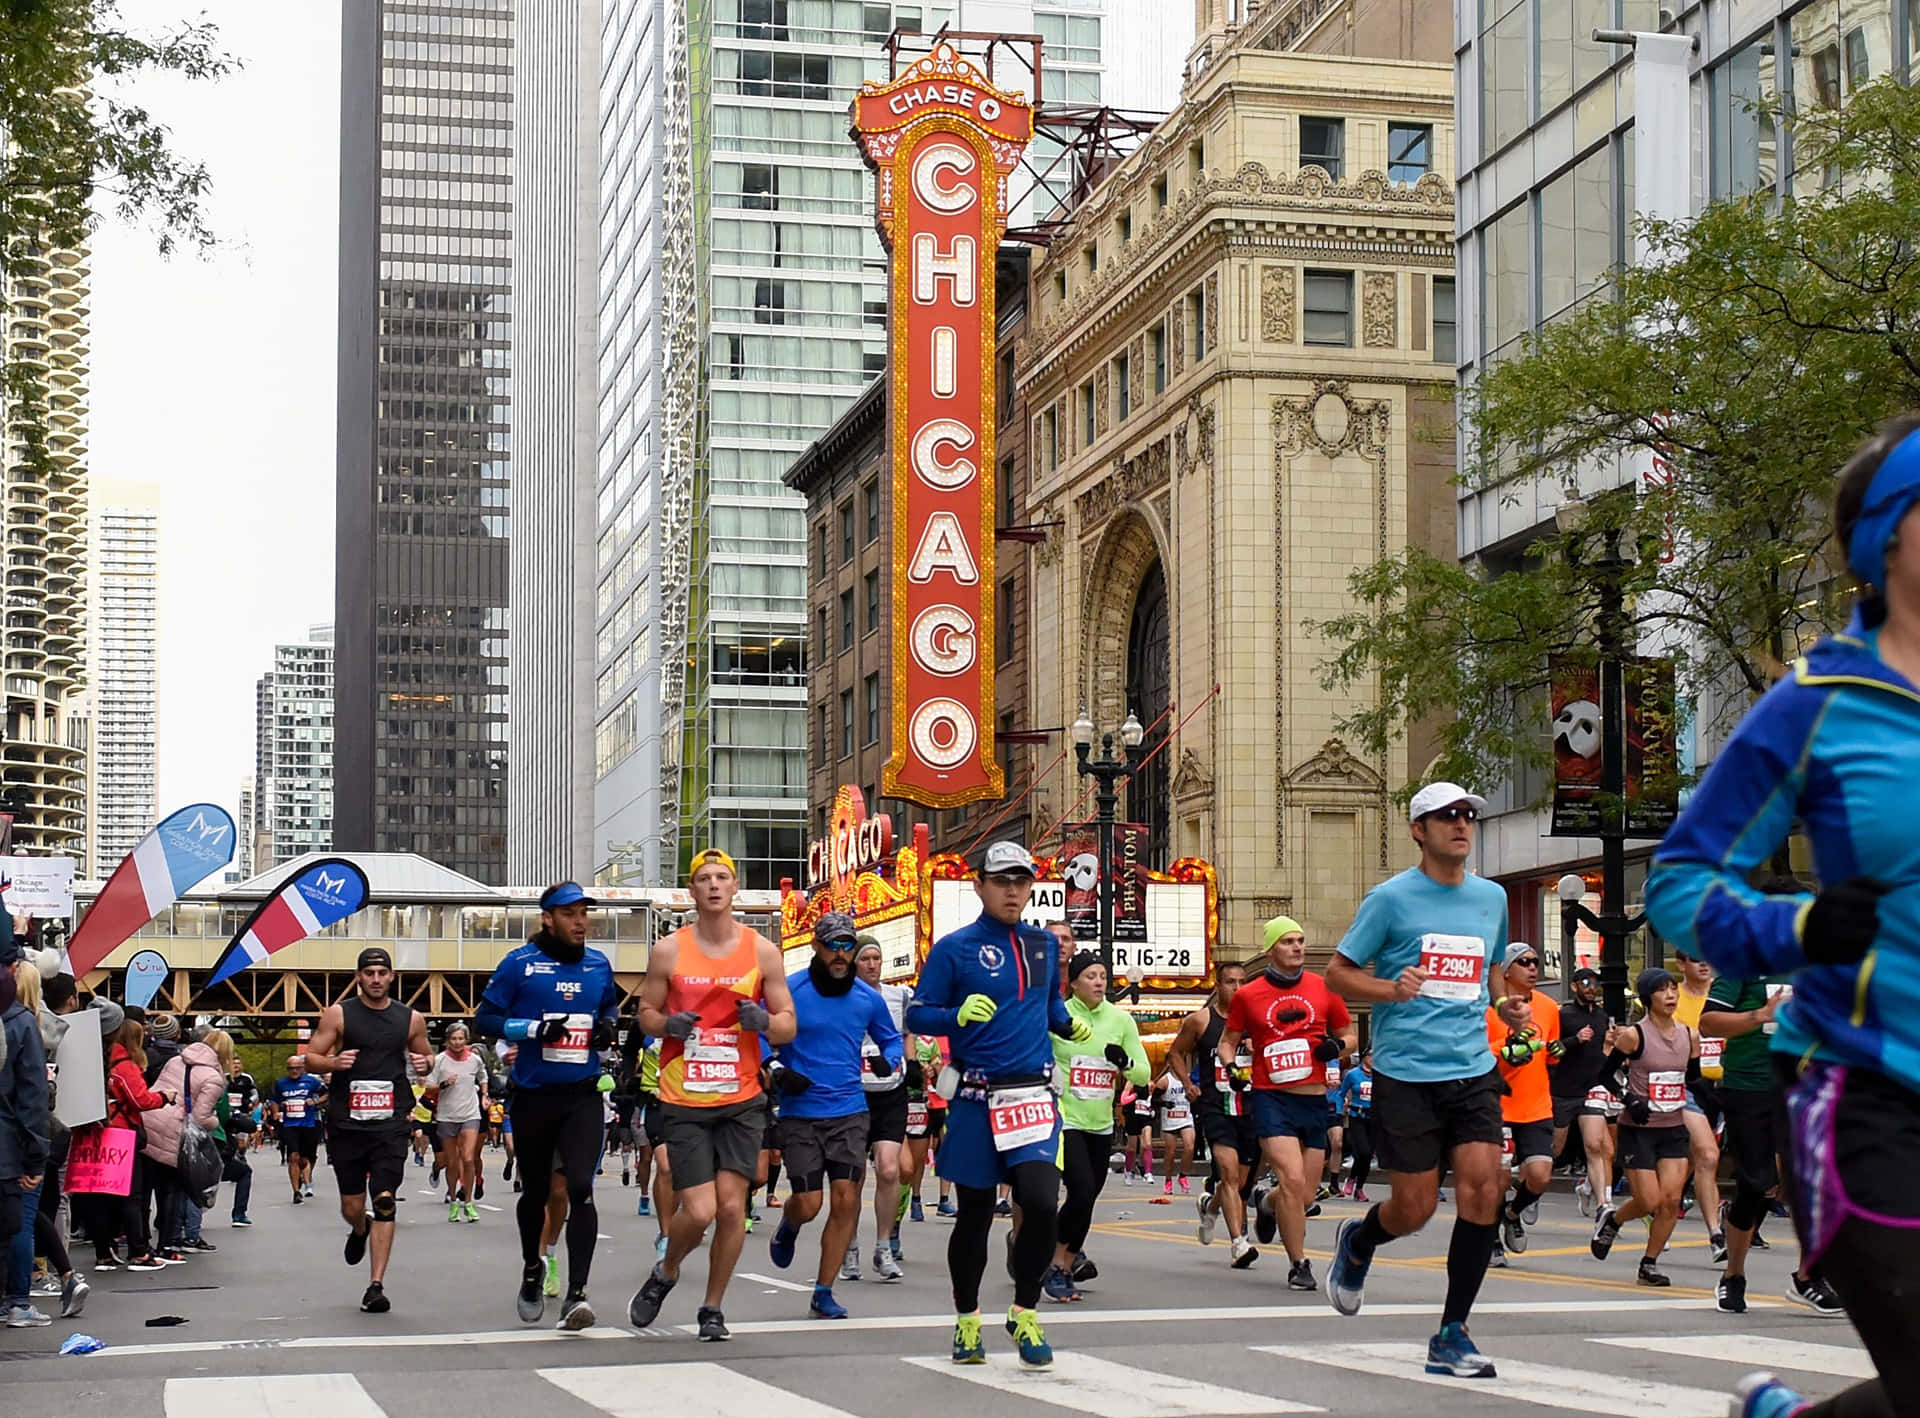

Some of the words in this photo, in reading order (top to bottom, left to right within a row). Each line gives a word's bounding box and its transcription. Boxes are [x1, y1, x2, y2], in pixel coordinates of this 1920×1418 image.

[889, 85, 976, 115] CHASE
[908, 143, 979, 770] CHICAGO
[808, 812, 882, 885] CHICAGO
[1123, 829, 1137, 912] PHANTOM
[1428, 956, 1439, 975] E
[1440, 957, 1474, 978] 2994
[555, 982, 582, 993] JOSE
[683, 976, 710, 985] TEAM
[1271, 1056, 1279, 1069] E
[1280, 1053, 1305, 1068] 4117
[687, 1063, 697, 1079] E
[699, 1063, 736, 1079] 19488
[1073, 1069, 1081, 1084] E
[1655, 1085, 1663, 1099] E
[995, 1111, 1007, 1130] E
[1009, 1103, 1054, 1127] 11918
